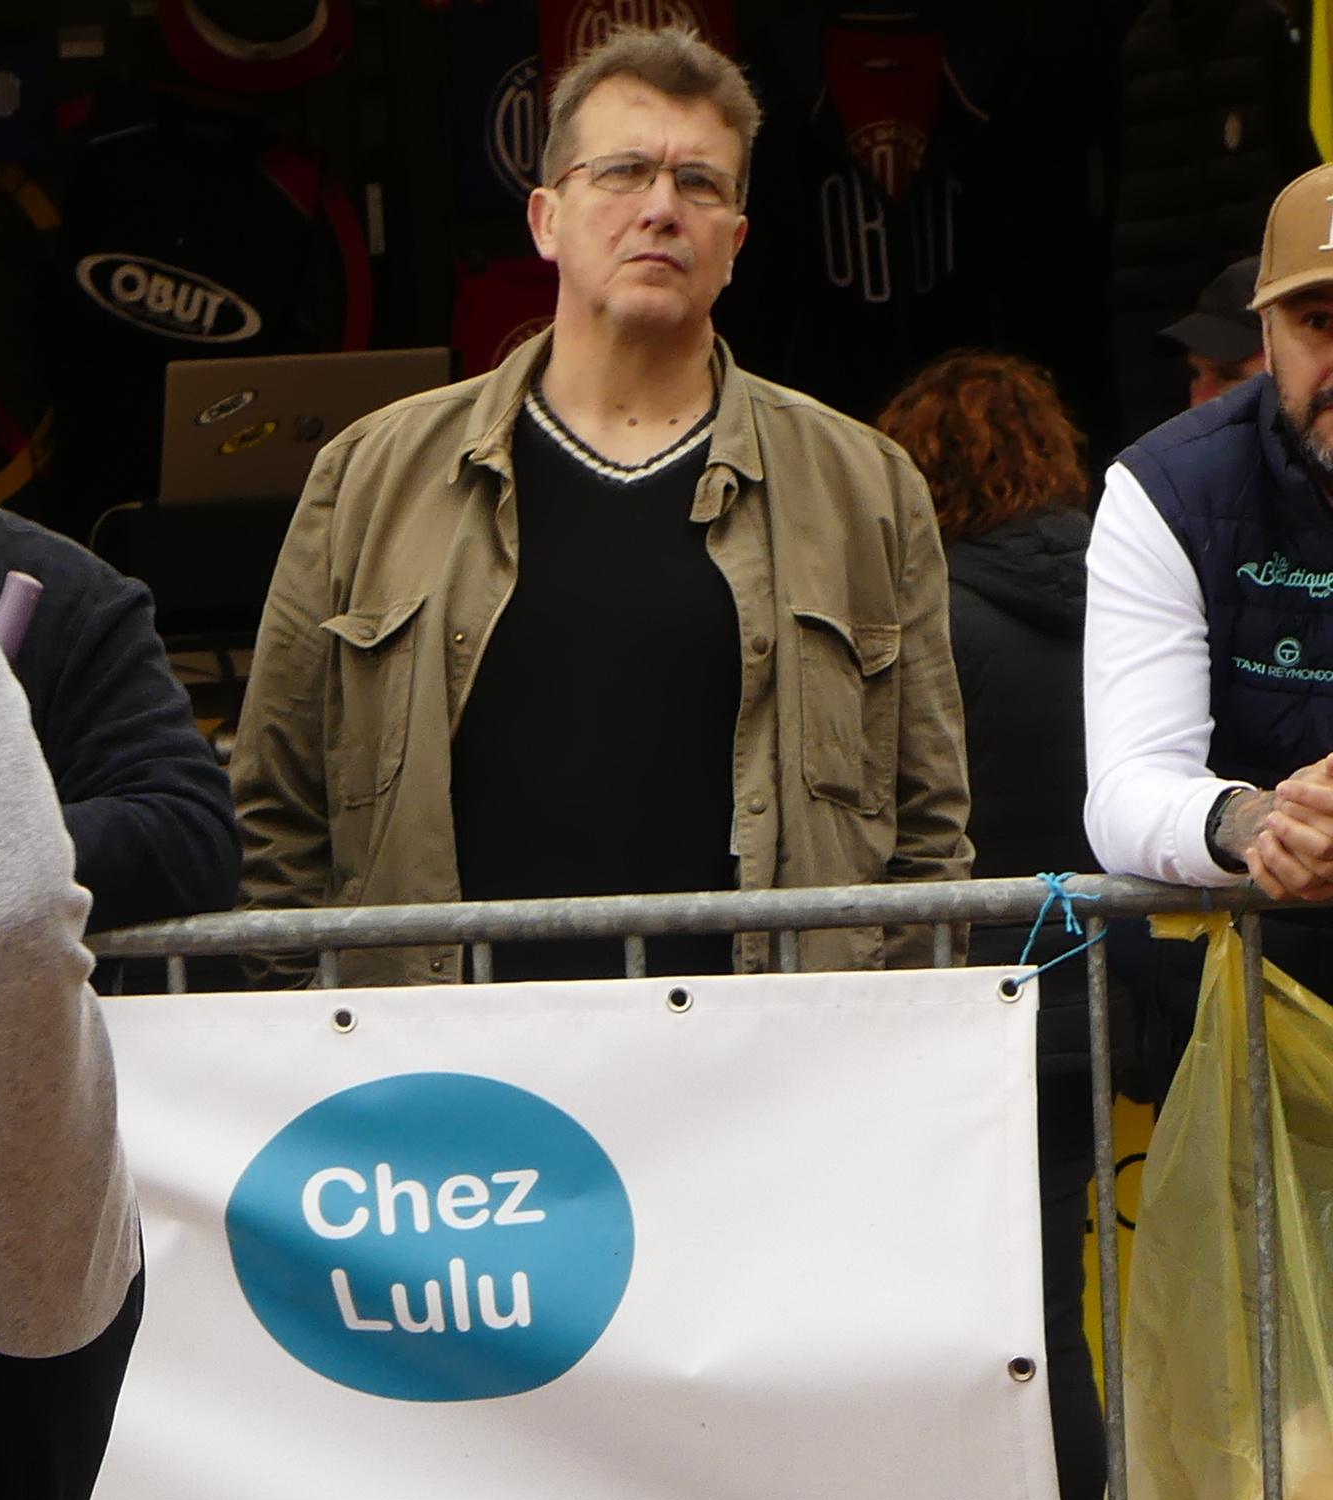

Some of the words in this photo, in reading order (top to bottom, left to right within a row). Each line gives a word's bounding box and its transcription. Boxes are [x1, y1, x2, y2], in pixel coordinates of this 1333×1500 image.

[109, 262, 227, 335] OBUT
[1233, 656, 1266, 675] TAXI
[301, 1162, 546, 1241] Chez
[329, 1256, 532, 1335] Lulu
